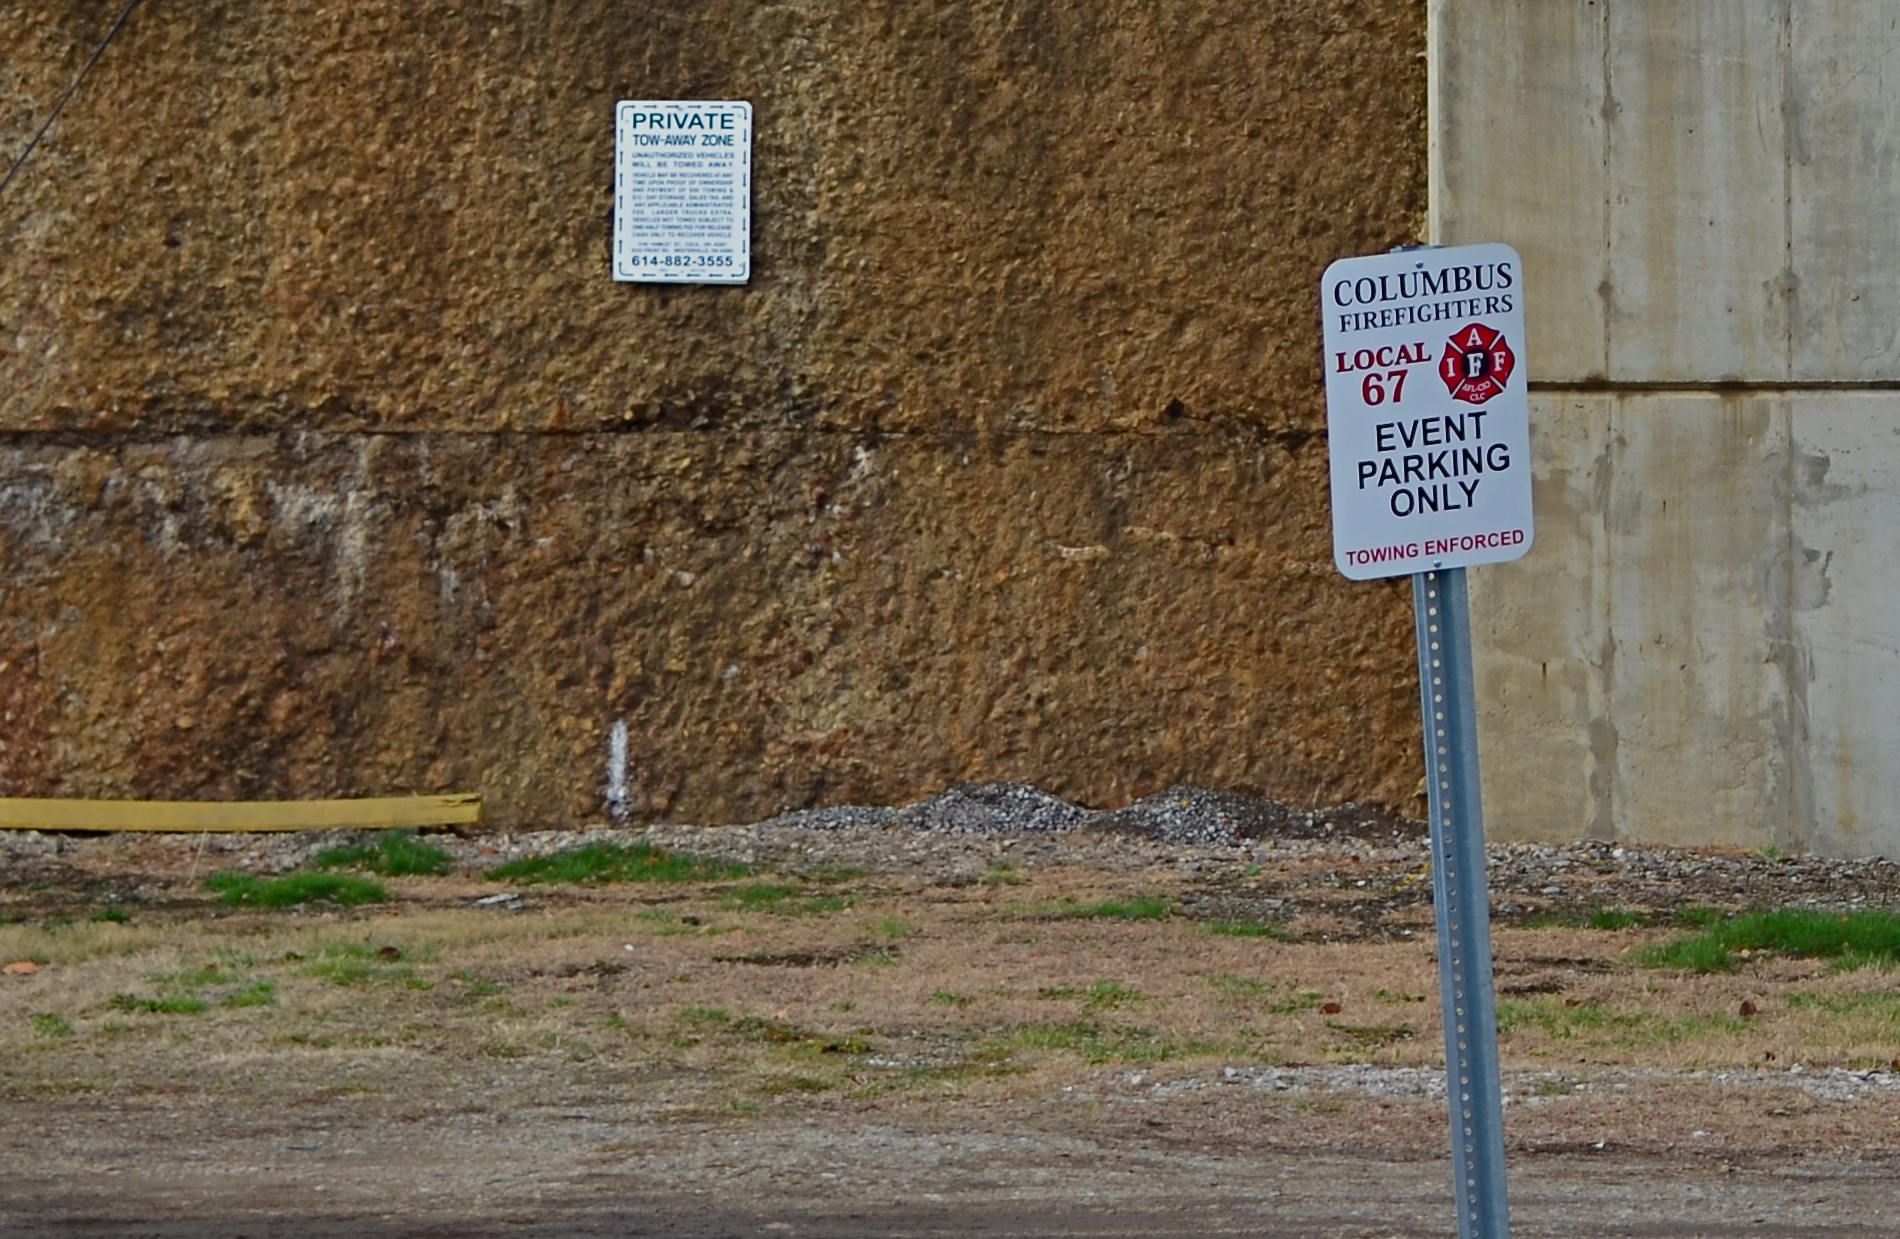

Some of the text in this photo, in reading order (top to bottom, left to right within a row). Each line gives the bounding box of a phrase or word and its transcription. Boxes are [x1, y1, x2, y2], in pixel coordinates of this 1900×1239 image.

[632, 113, 734, 129] PRIVATE
[633, 134, 734, 146] TOW-AWAY ZONE
[631, 255, 733, 267] 614-882-3555
[1334, 262, 1513, 307] COLUMBUS
[1339, 294, 1514, 333] FIREFIGHTERS
[1336, 342, 1432, 373] LOCAL
[1362, 370, 1408, 406] 67
[1376, 411, 1487, 452] EVENT
[1358, 443, 1511, 489] PARKING
[1390, 479, 1480, 517] ONLY
[1346, 529, 1525, 566] TOWING ENFORCED
